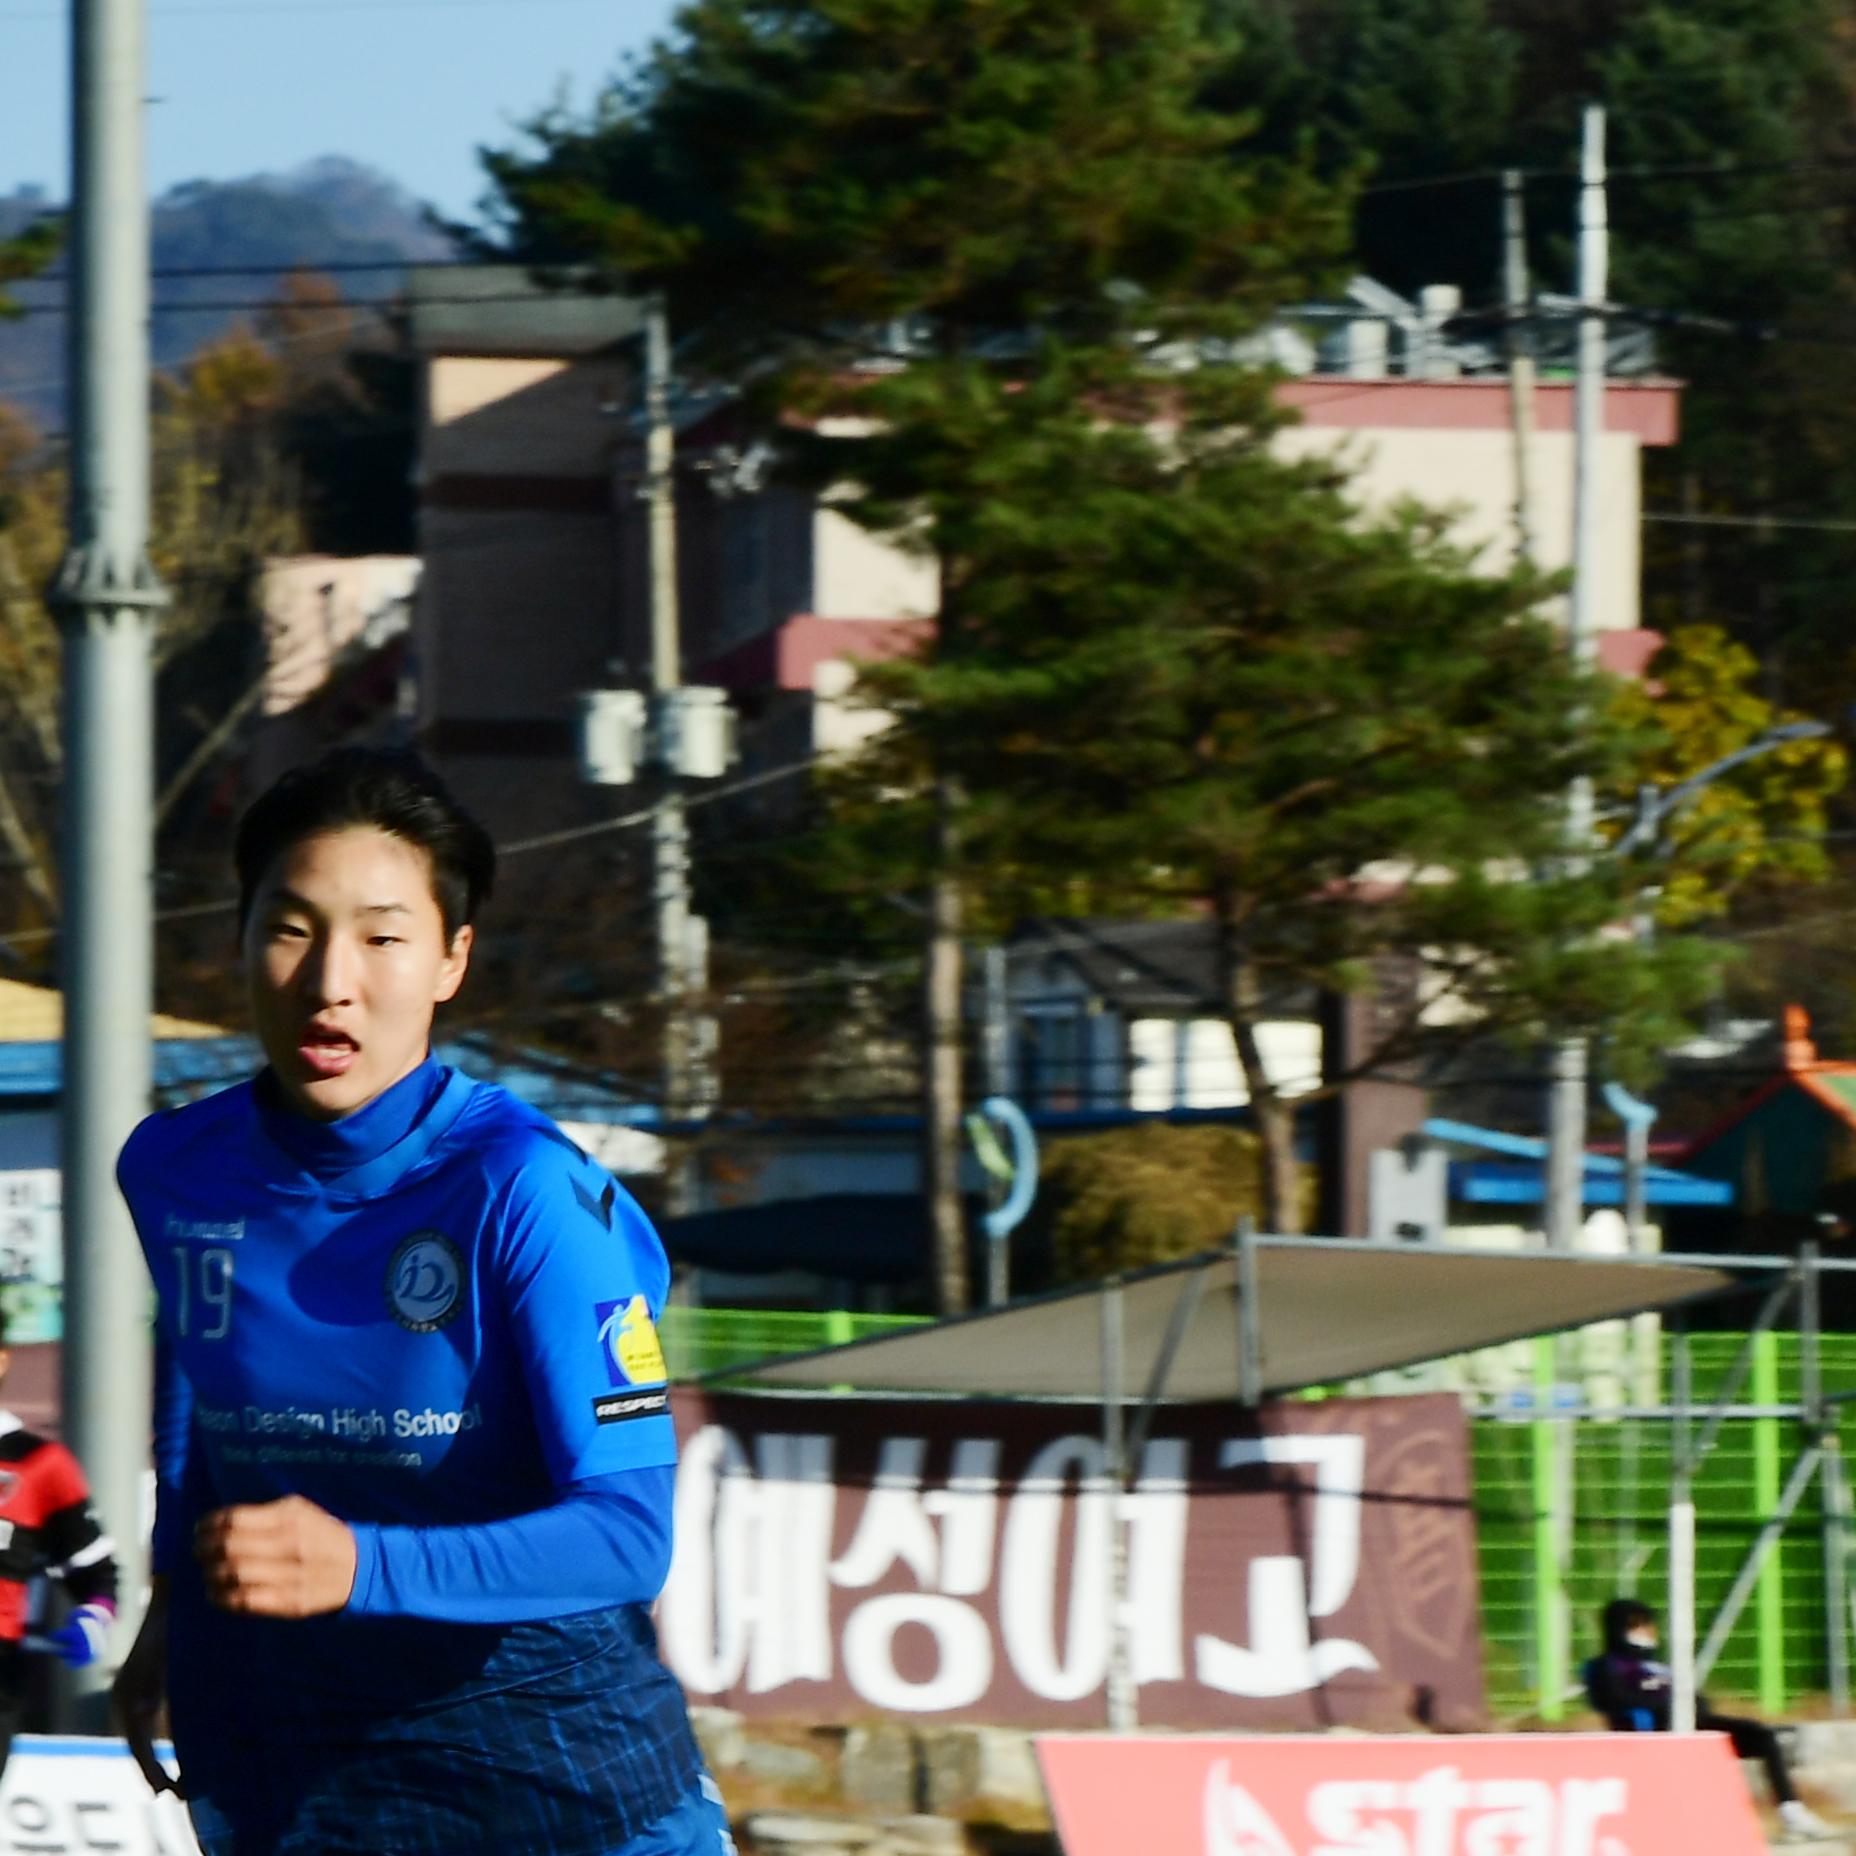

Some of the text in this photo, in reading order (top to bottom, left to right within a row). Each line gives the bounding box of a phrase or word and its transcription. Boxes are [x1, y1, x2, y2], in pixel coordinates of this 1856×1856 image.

[172, 1246, 235, 1339] 19
[244, 1406, 325, 1440] Design
[332, 1407, 386, 1442] High
[393, 1403, 483, 1439] School
